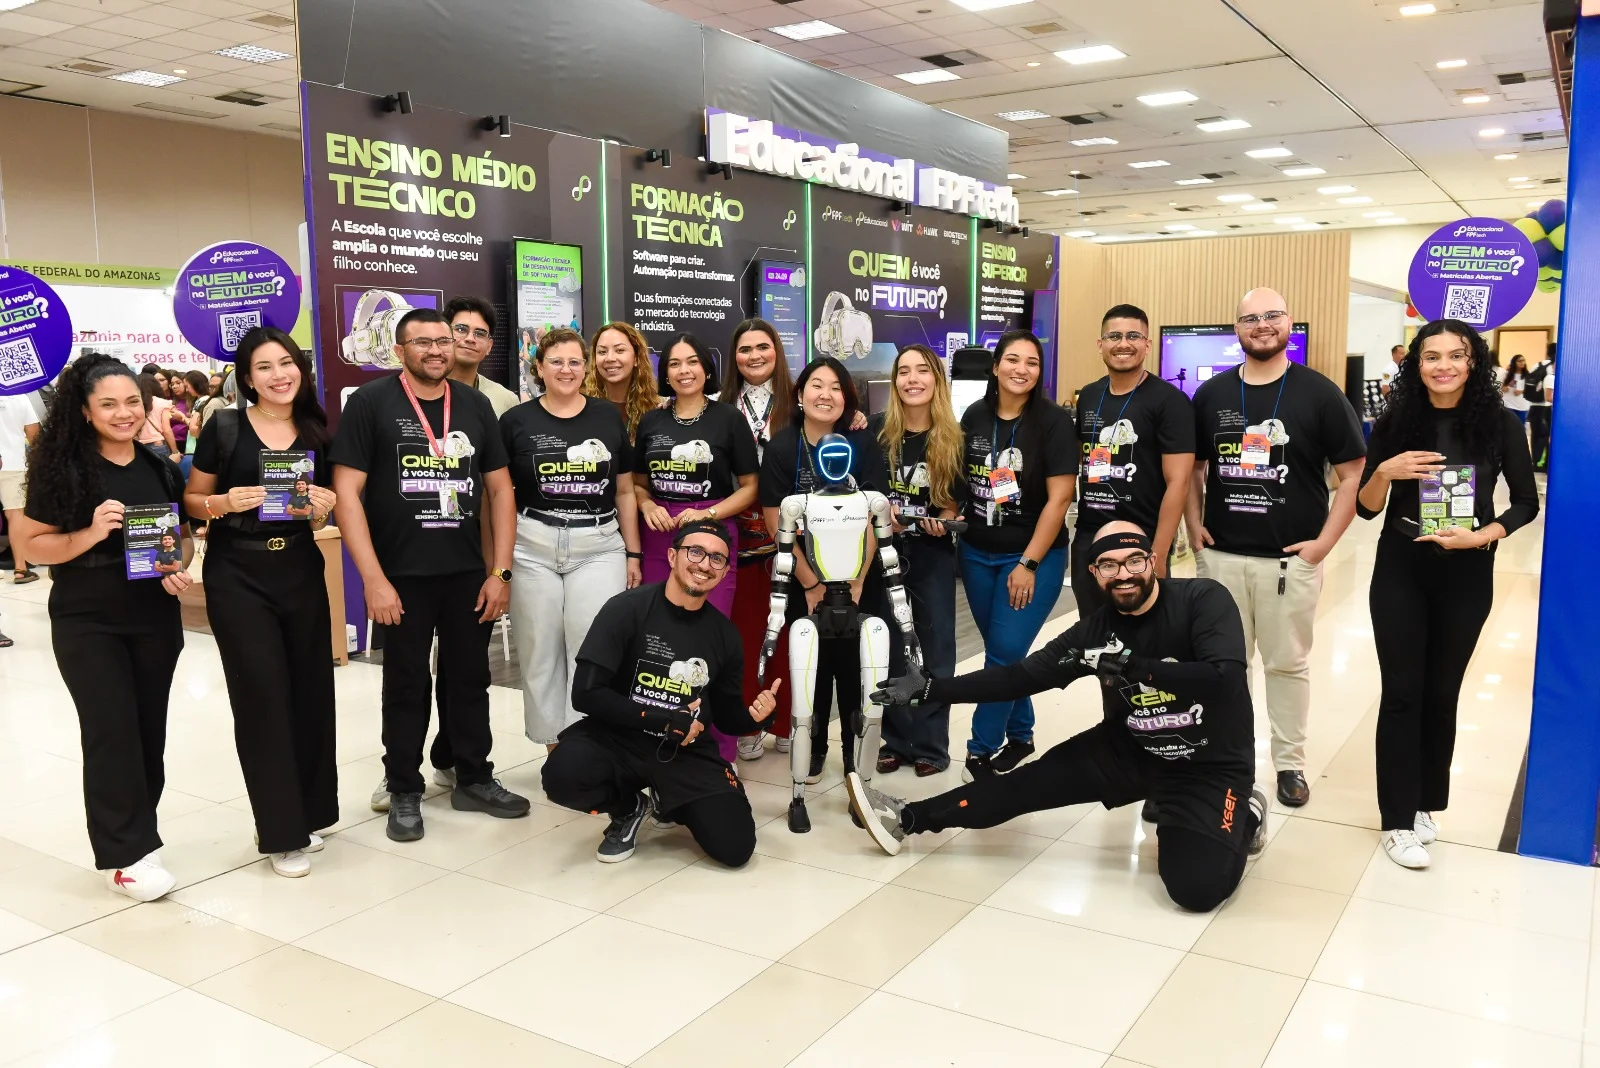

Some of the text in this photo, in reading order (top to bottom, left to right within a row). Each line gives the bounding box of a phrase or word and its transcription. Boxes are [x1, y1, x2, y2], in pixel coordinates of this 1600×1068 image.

[326, 132, 536, 192] ENSINO MÉDIO
[328, 170, 476, 220] TÉCNICO
[630, 182, 744, 222] FORMAÇÃO
[331, 220, 483, 246] A Escola que você escolhe
[632, 210, 724, 248] TÉCNICA
[222, 248, 258, 257] Educacional
[332, 238, 478, 262] amplia o mundo que seu
[632, 250, 706, 266] Software para criar.
[982, 242, 1016, 262] ENSINO
[1430, 245, 1486, 258] QUEM
[333, 256, 418, 274] filho conhece.
[523, 254, 550, 264] FORMAÇÃO
[848, 250, 940, 280] QUEM é você
[1443, 256, 1524, 276] FUTURO?
[34, 266, 82, 278] FEDERAL
[85, 268, 100, 278] DO
[103, 269, 160, 281] AMAZONAS
[190, 271, 247, 287] QUEM
[255, 270, 275, 278] você
[633, 265, 736, 282] Automação para transformar.
[982, 262, 1028, 282] SUPERIOR
[208, 276, 286, 299] FUTURO?
[5, 291, 35, 306] é você
[208, 300, 242, 309] Matrículas
[634, 292, 732, 308] Duas formações conectadas
[855, 283, 948, 320] no FUTURO?
[646, 308, 678, 318] mercado
[680, 308, 689, 318] de
[690, 308, 725, 322] tecnologia
[9, 322, 36, 334] Abertas
[641, 320, 676, 333] indústria.
[179, 354, 186, 363] e
[1218, 443, 1241, 455] QU
[402, 455, 459, 468] QUEM
[539, 462, 596, 474] QUEM
[649, 460, 696, 472] QUEM
[403, 469, 408, 477] é
[411, 469, 435, 477] você
[638, 672, 692, 696] QUEM
[636, 685, 641, 693] é
[643, 688, 667, 701] você
[669, 695, 680, 703] no
[1152, 706, 1167, 715] no
